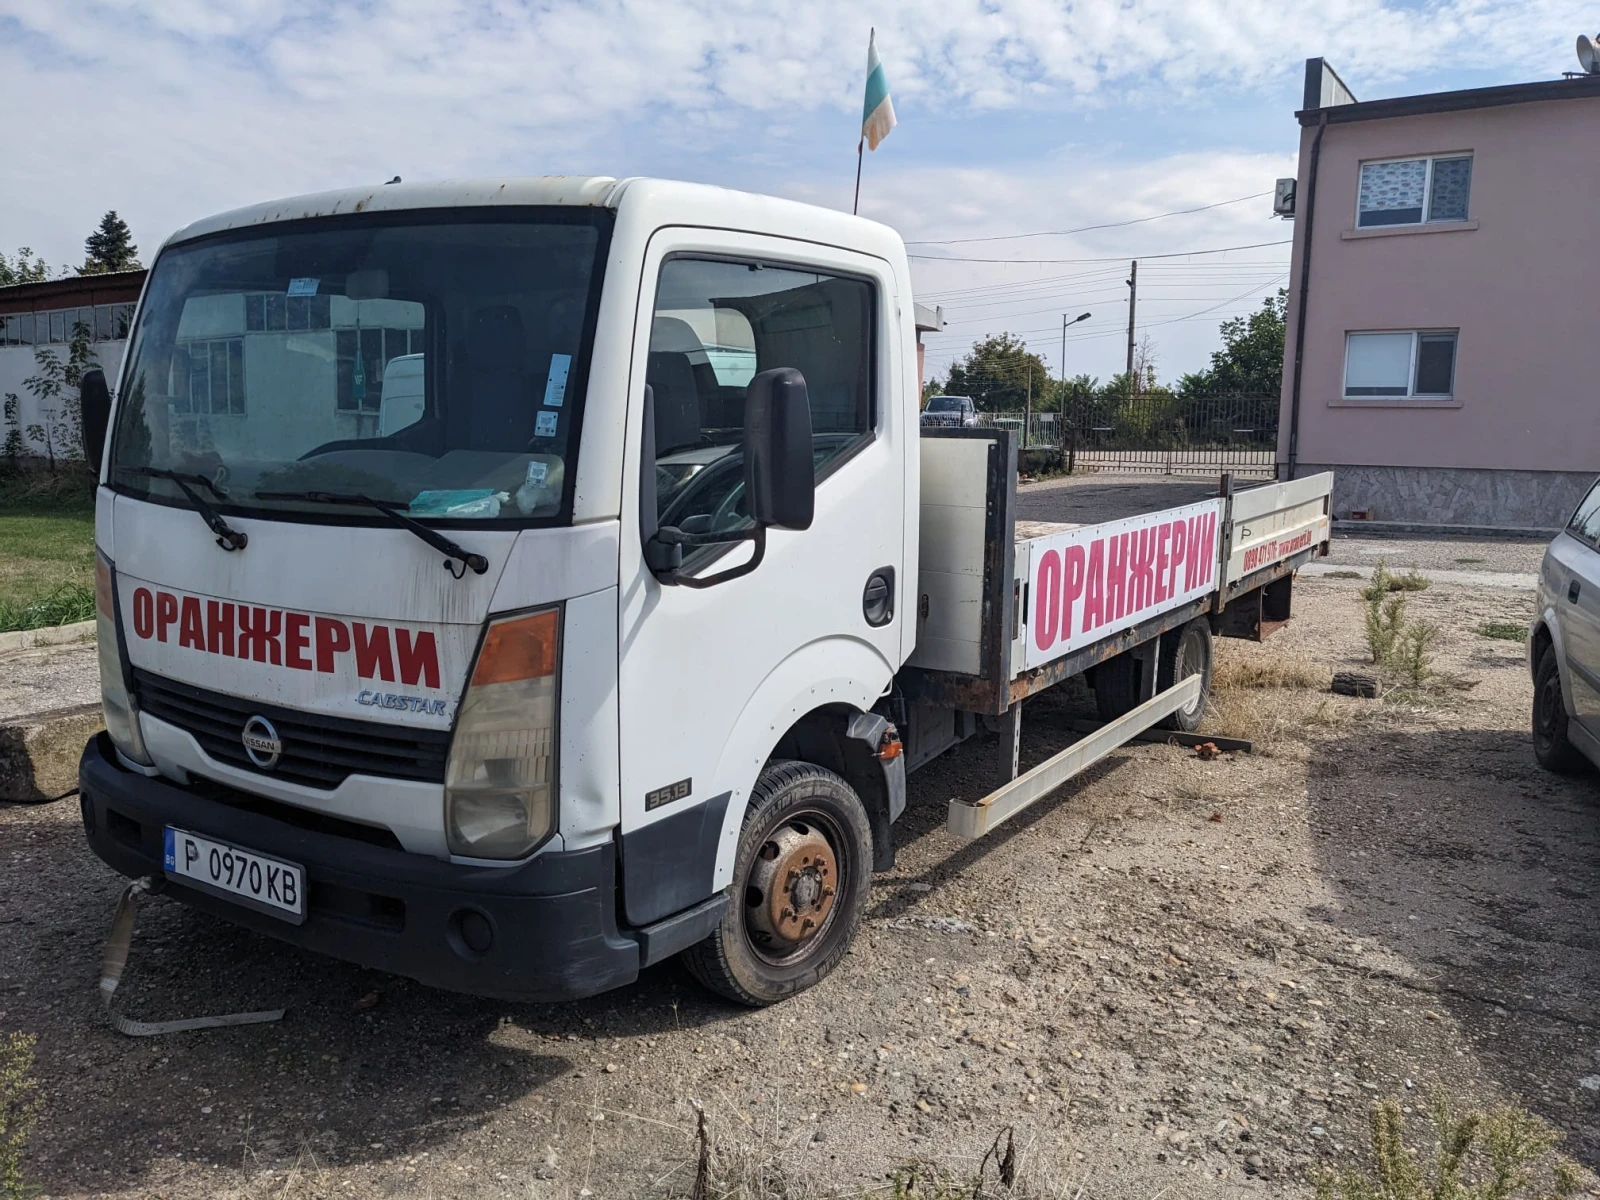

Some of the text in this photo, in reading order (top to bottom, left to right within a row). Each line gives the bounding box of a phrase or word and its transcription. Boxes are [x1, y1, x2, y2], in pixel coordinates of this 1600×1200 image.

[1035, 511, 1216, 652] ОРАНЖЕРИИ
[132, 587, 440, 689] ОРАНЖЕРИИ
[357, 689, 447, 716] CABSTAR
[243, 735, 275, 751] NISSAN
[649, 781, 689, 809] 35.13
[165, 854, 175, 866] BG
[185, 839, 199, 872] P
[209, 848, 262, 895] 0970
